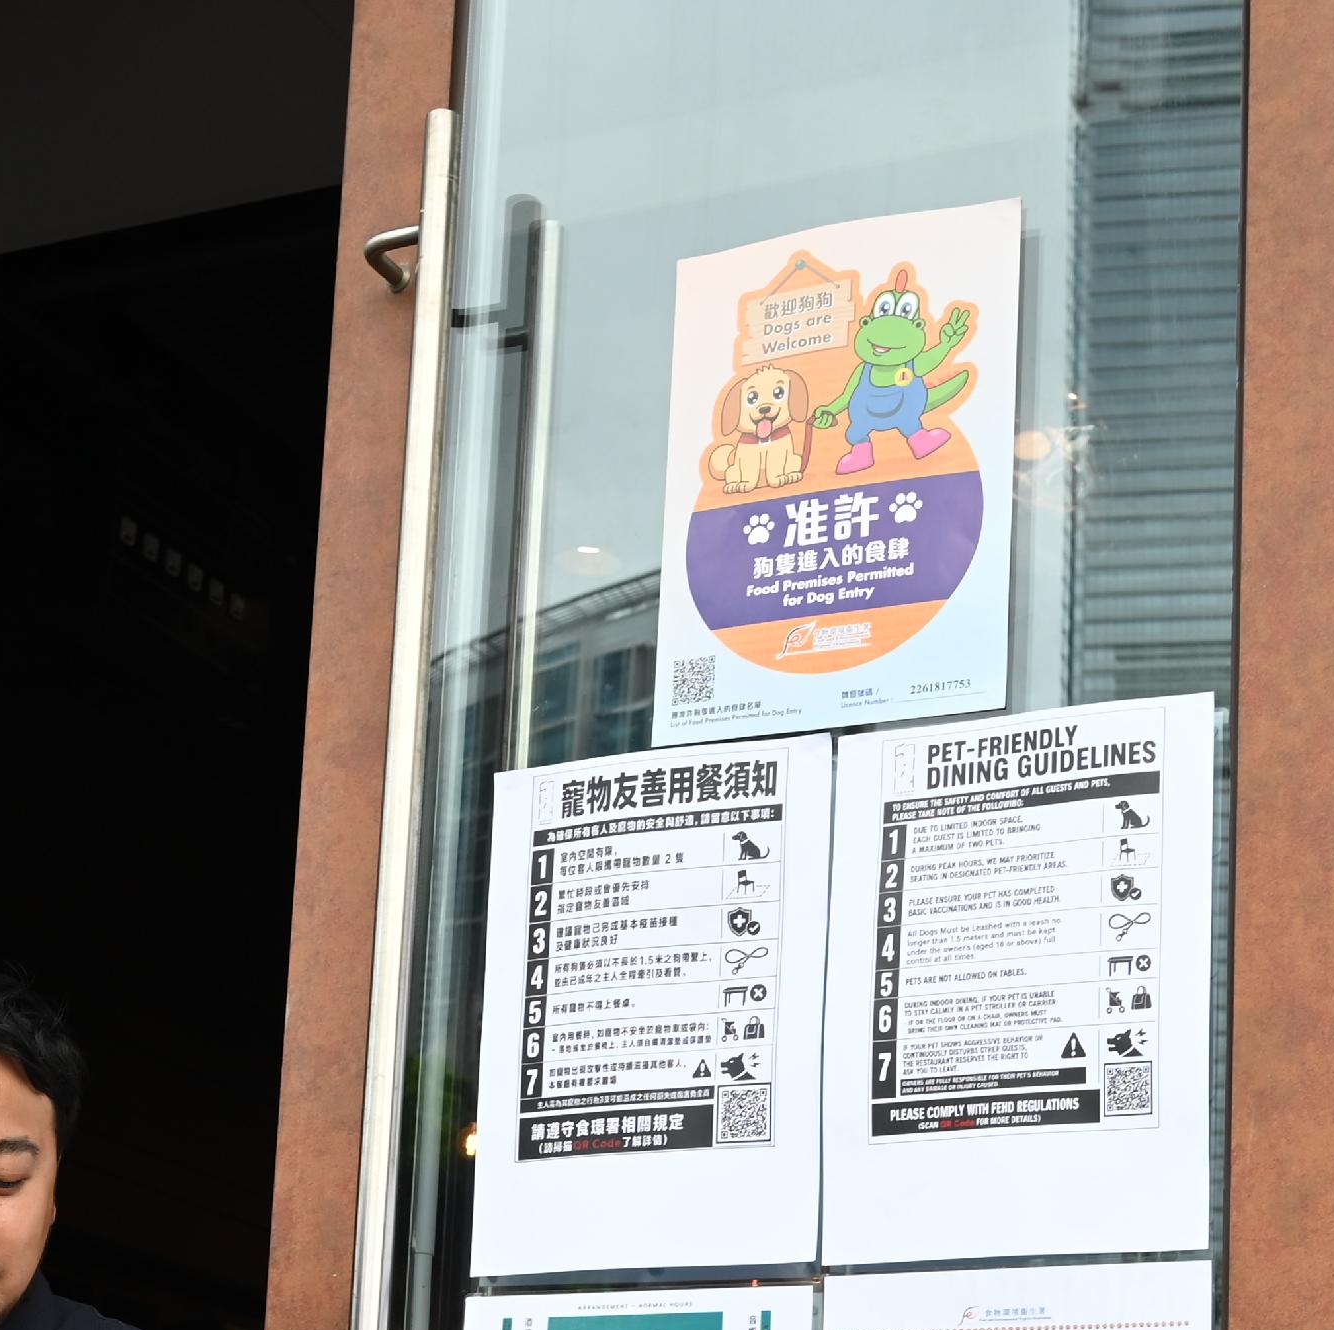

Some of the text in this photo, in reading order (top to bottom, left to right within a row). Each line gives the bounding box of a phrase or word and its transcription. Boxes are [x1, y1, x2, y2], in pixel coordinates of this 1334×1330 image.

[765, 292, 832, 319] 歡迎狗狗
[764, 314, 832, 336] Dogs are
[762, 333, 831, 354] Welcome
[783, 492, 879, 547] 准許
[753, 537, 909, 579] 狗隻進入的食肆
[747, 563, 914, 596] Food Premises Permitted
[783, 586, 875, 606] for Dog Entry
[910, 679, 971, 694] 2261817753
[927, 725, 1077, 764] PET-FRIENDLY
[927, 741, 1156, 789] DINING GUIDELINES
[561, 760, 777, 819] 寵物友善用餐須知
[892, 803, 901, 812] TO
[902, 801, 928, 811] ENSURE
[931, 799, 942, 807] THE
[945, 795, 968, 806] SAFETY
[971, 794, 984, 803] AND
[986, 789, 1019, 802] COMFORT
[1021, 789, 1029, 797] OF
[1032, 787, 1044, 796] ALL
[1046, 783, 1072, 795] GUESTS
[1074, 781, 1089, 791] AND
[892, 811, 916, 821] PLEASE
[918, 809, 934, 818] TAKE
[937, 807, 954, 816] NOTE
[957, 806, 965, 814] OF
[968, 804, 980, 812] THE
[889, 829, 898, 854] 1
[538, 855, 547, 879] 1
[910, 875, 937, 883] SEATING
[950, 869, 990, 878] DESIGNATED
[994, 864, 1041, 874] PET-FRIENDLY
[911, 864, 936, 873] DURING
[939, 862, 955, 870] PEAK
[1017, 852, 1054, 862] PRIORITIZE
[885, 864, 898, 888] 2
[535, 891, 547, 916] 2
[908, 908, 926, 917] BASIC
[930, 903, 977, 914] VACCINATIONS
[979, 901, 992, 909] AND
[995, 900, 1002, 908] IS
[1013, 898, 1031, 906] GOOD
[909, 897, 932, 906] PLEASE
[936, 894, 961, 903] ENSURE
[965, 893, 981, 901] YOUR
[998, 889, 1011, 897] HAS
[1014, 885, 1055, 896] COMPLETED
[883, 897, 896, 922] 3
[533, 928, 545, 954] 3
[882, 934, 894, 962] 4
[531, 966, 543, 989] 4
[880, 972, 893, 997] 5
[906, 977, 921, 985] PETS
[939, 974, 952, 982] NOT
[955, 971, 986, 981] ALLOWED
[529, 1001, 541, 1024] 5
[879, 1005, 891, 1032] 6
[527, 1033, 539, 1057] 6
[879, 1053, 891, 1082] 7
[526, 1069, 538, 1096] 7
[890, 1097, 1079, 1121] PLEASE COMPLY WITH FEHD REGULATIONS
[977, 1118, 988, 1126] FOR
[1012, 1115, 1041, 1124] DETAILS)
[531, 1114, 684, 1141] 請遵守食環署相關規定
